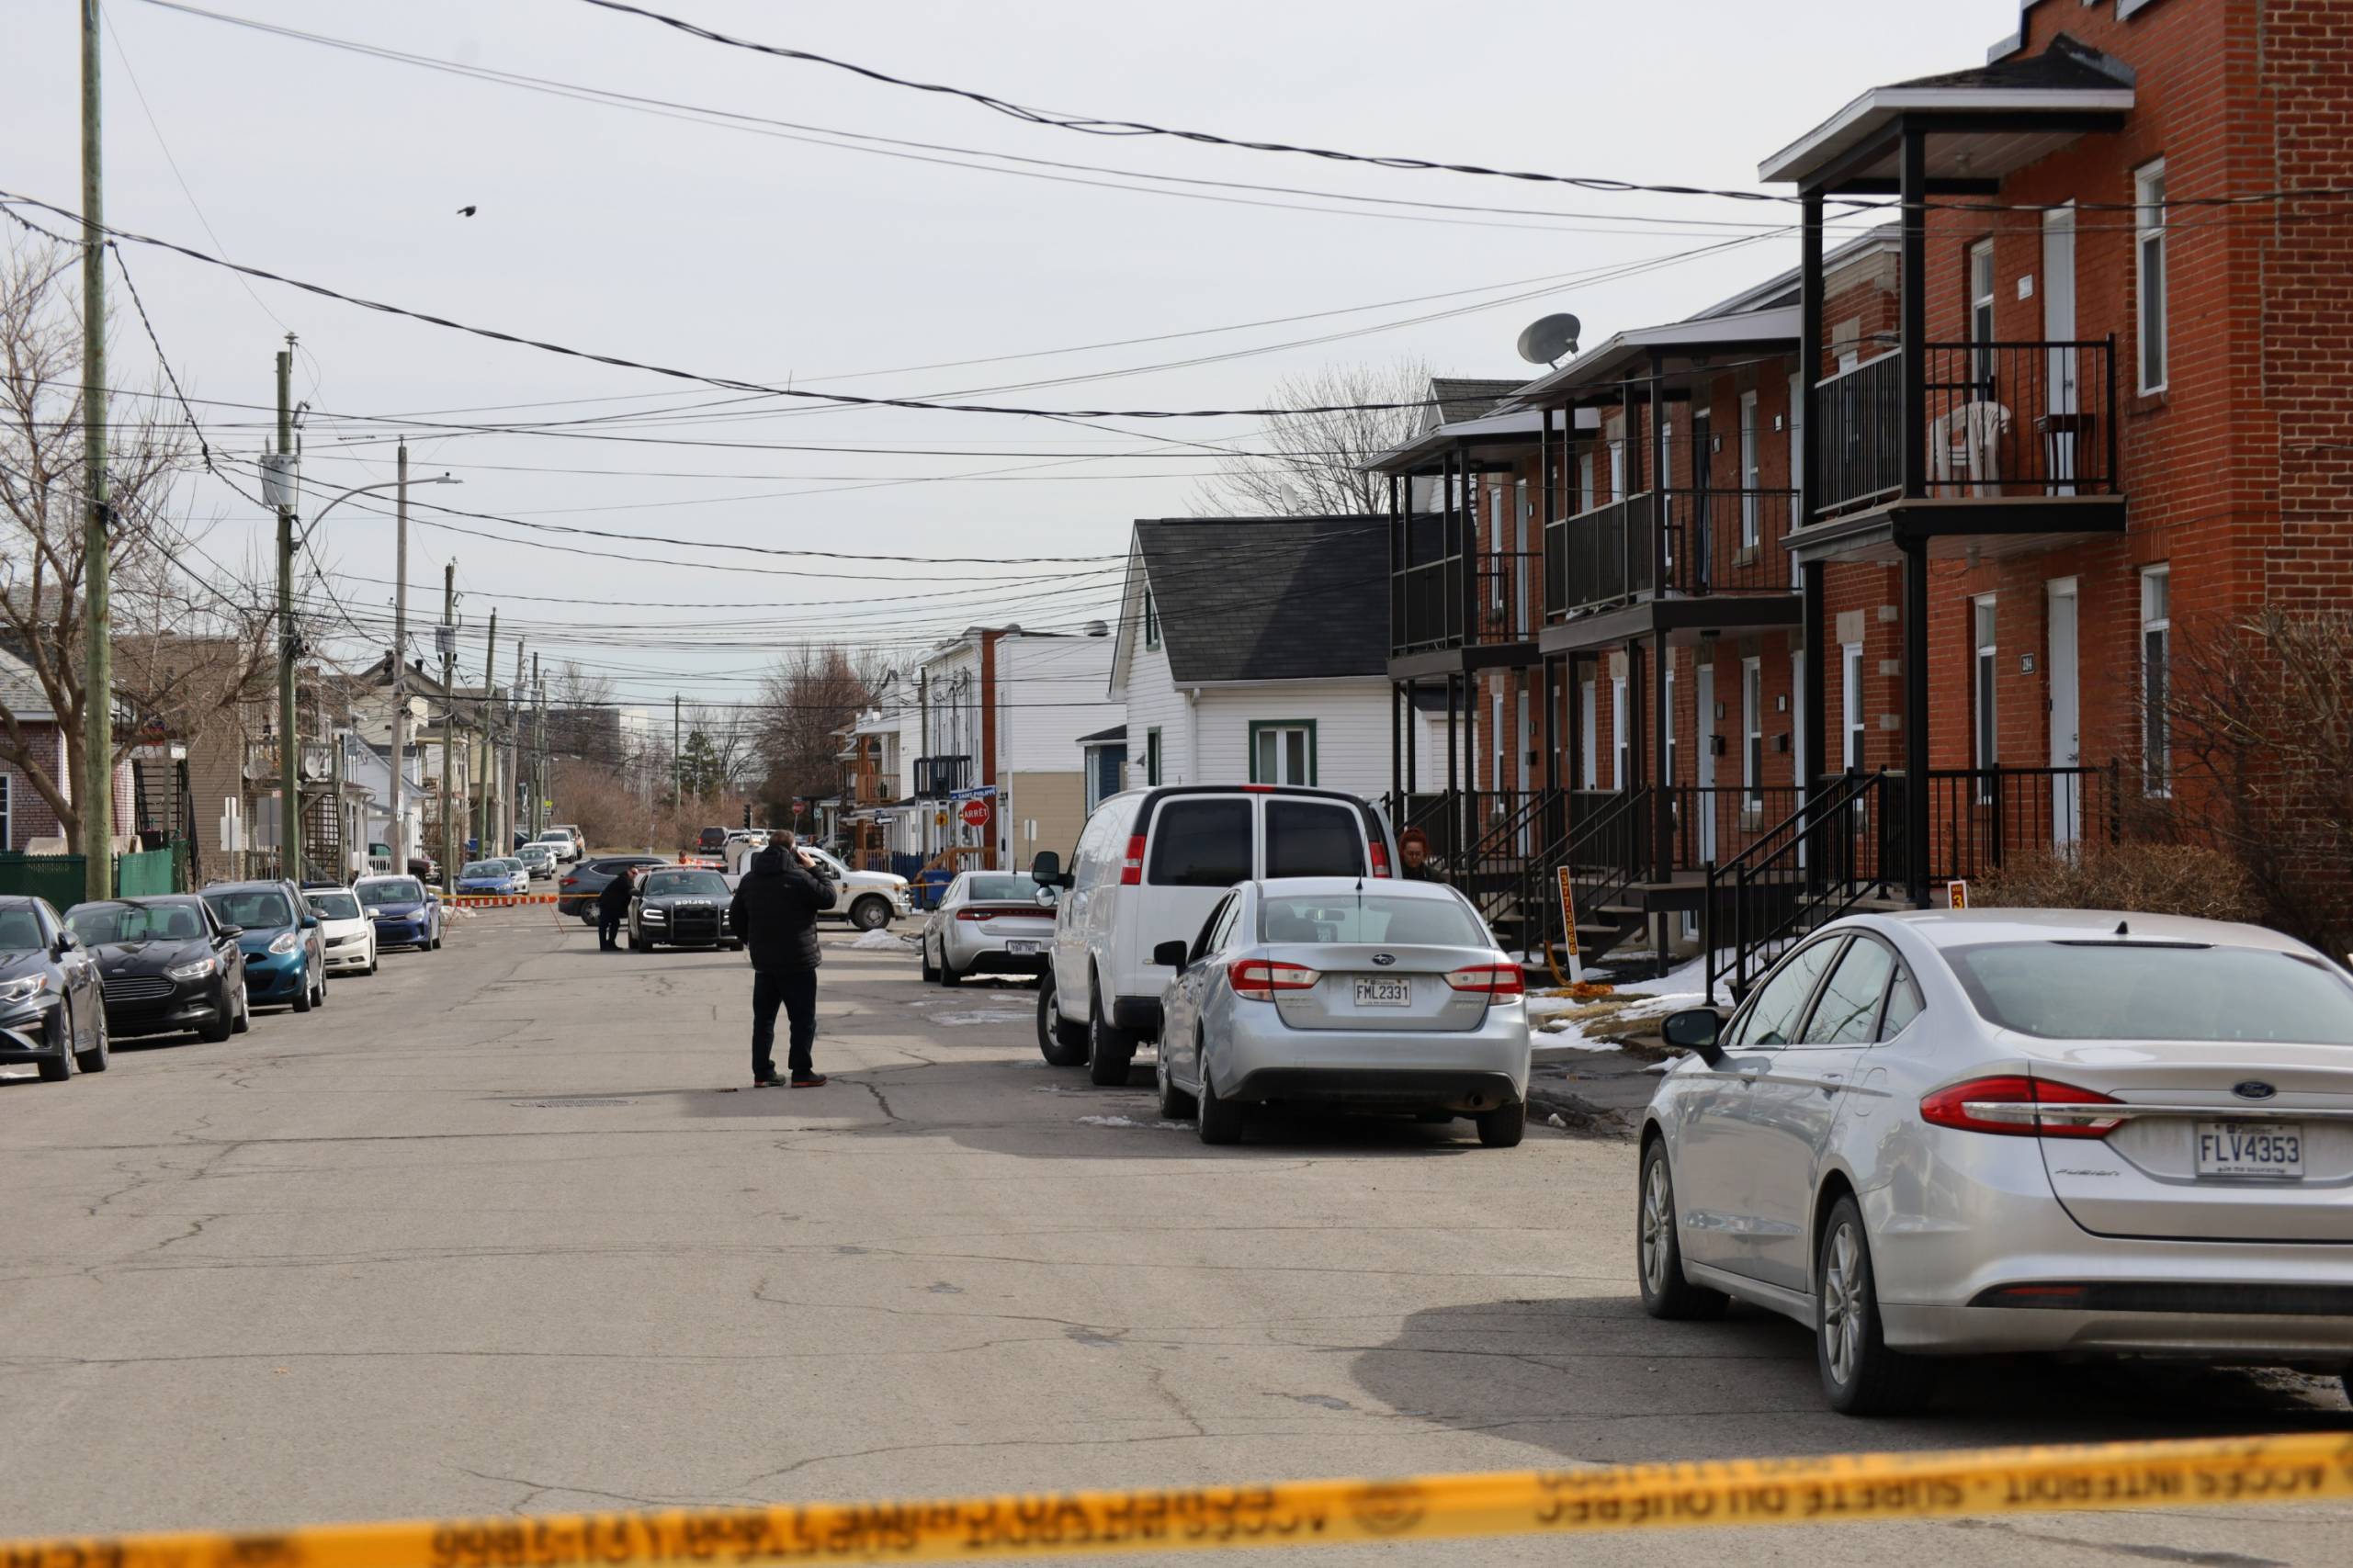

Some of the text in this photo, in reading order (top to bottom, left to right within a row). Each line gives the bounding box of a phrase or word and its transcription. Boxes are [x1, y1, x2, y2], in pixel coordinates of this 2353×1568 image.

[965, 807, 987, 818] ARRÊT
[1357, 985, 1408, 1000] FML2331
[2200, 1134, 2300, 1163] FLV4353
